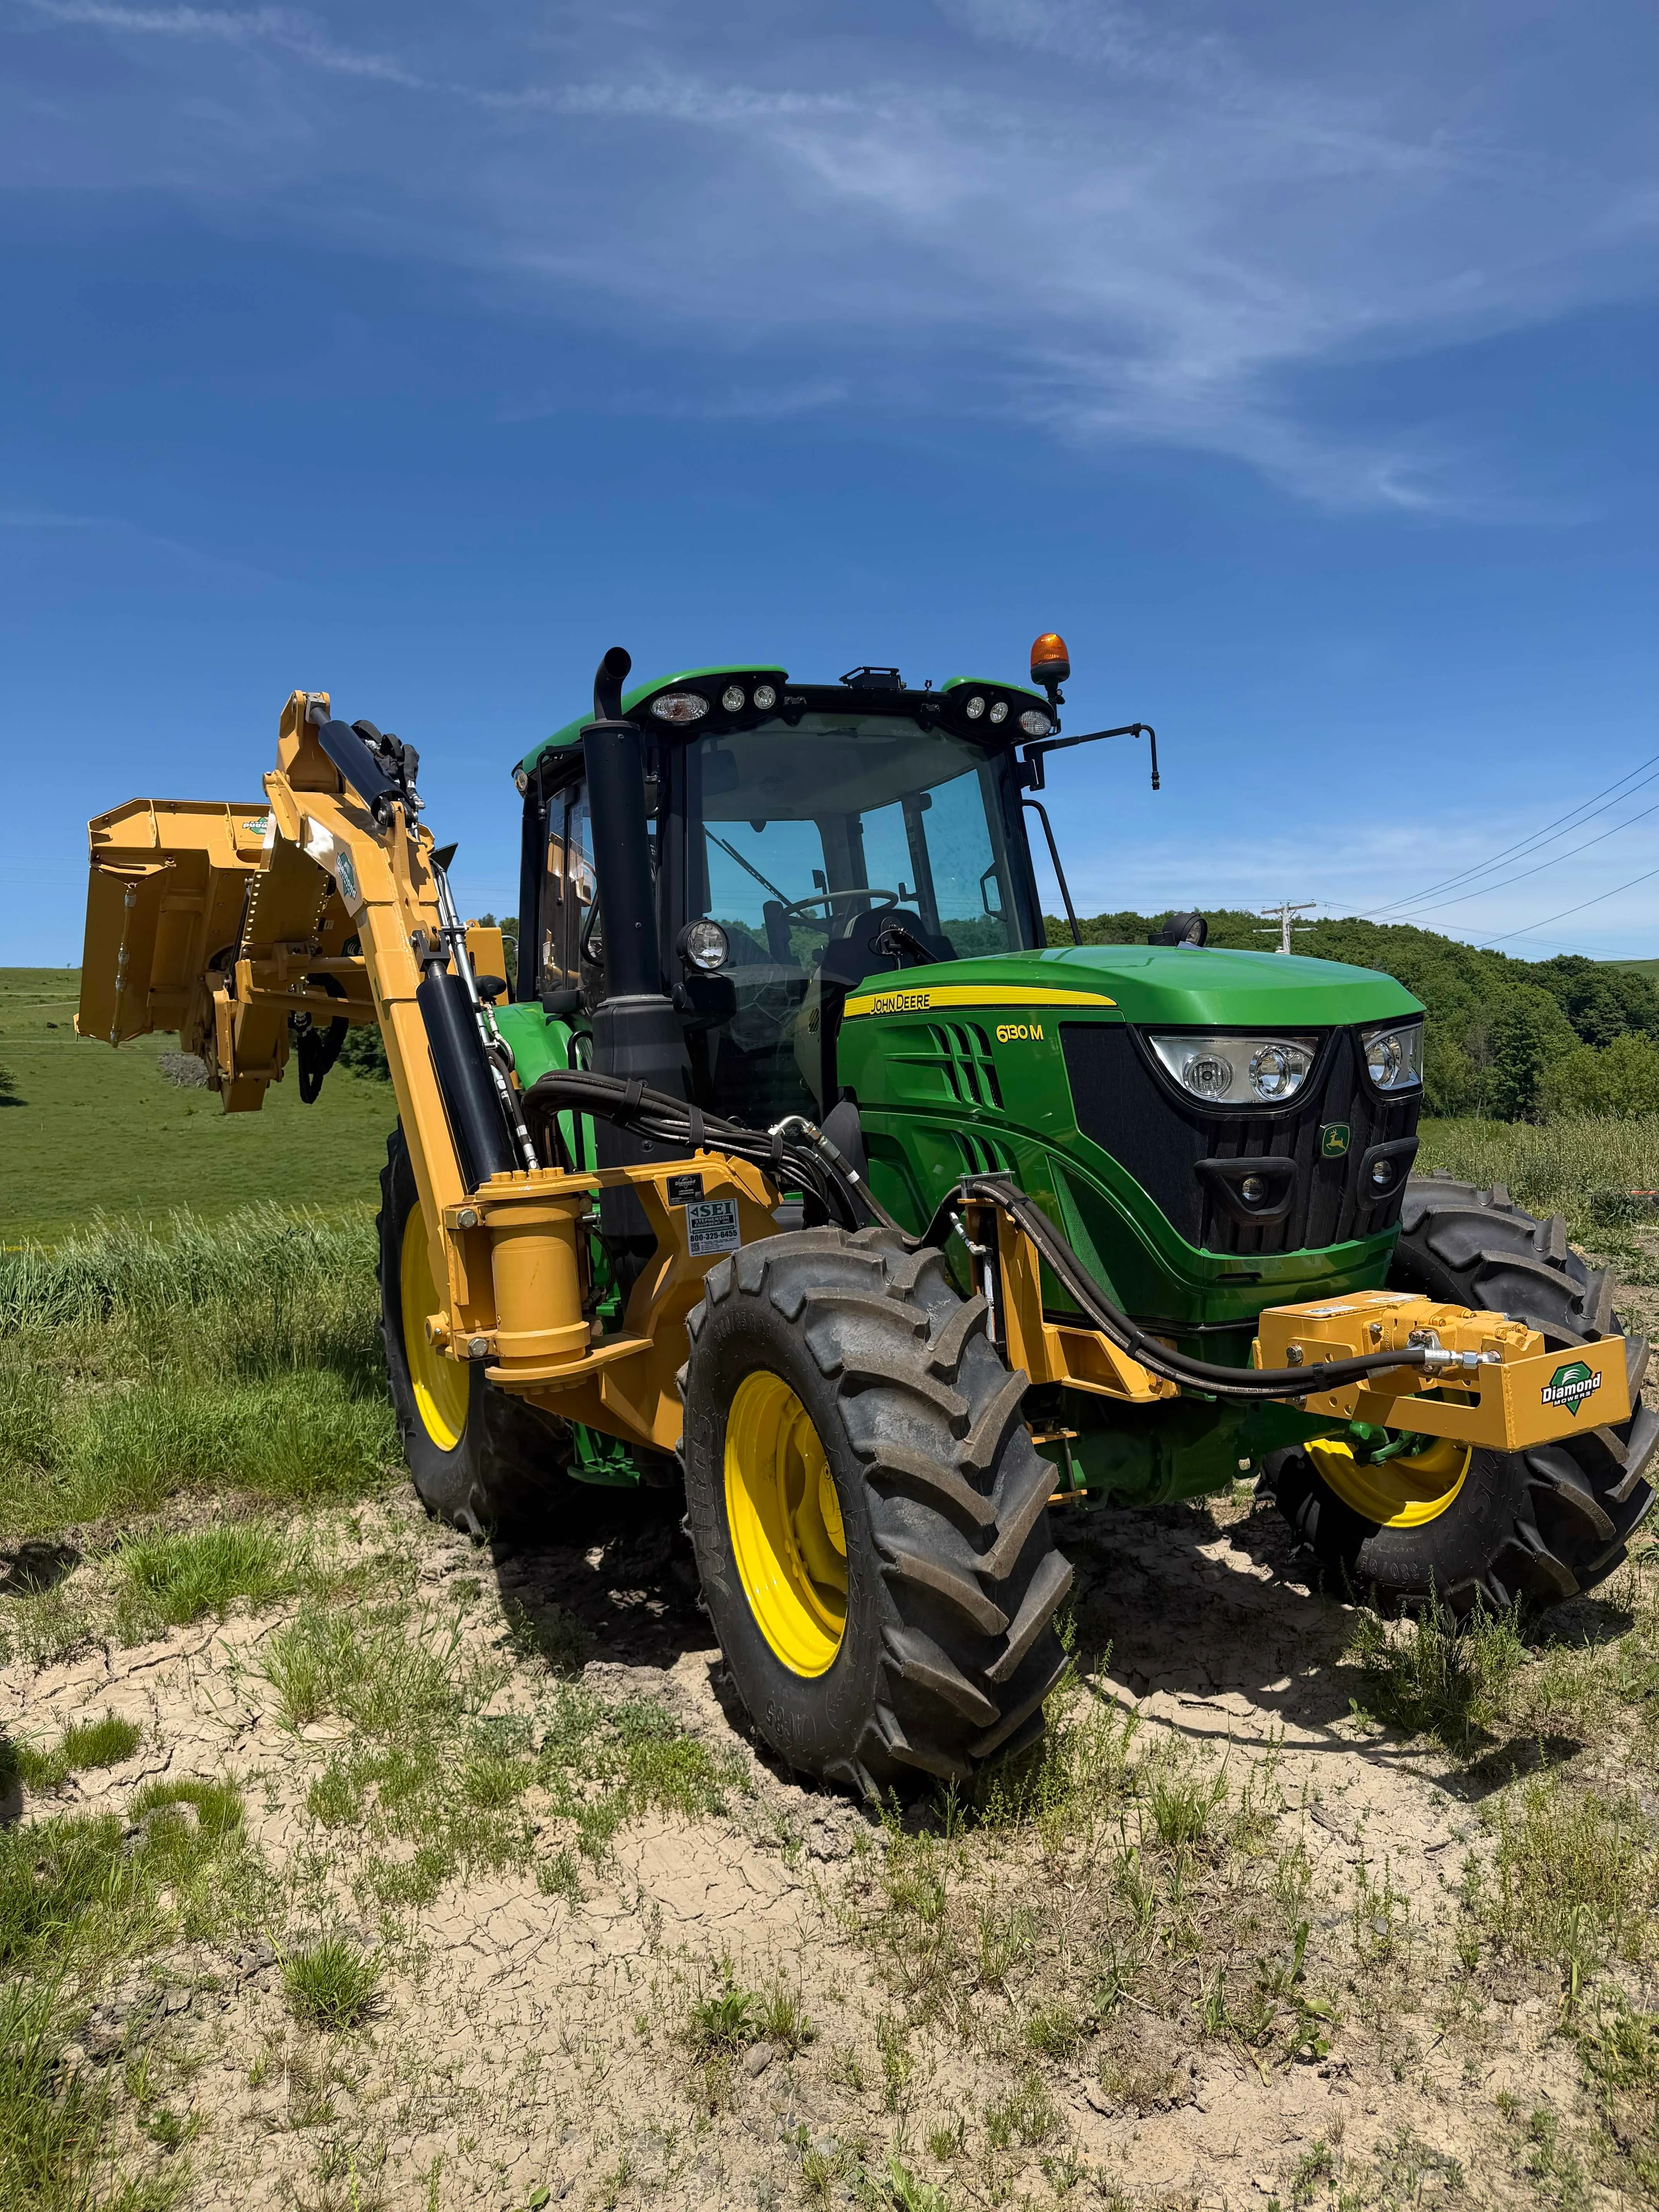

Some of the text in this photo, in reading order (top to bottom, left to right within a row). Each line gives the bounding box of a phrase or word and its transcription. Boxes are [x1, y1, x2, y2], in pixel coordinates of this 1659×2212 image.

[871, 994, 930, 1014] JOHN DEERE
[996, 1024, 1044, 1043] 6130 M
[700, 1202, 732, 1217] SEI
[690, 1230, 737, 1242] 800-325-6455
[1542, 1373, 1601, 1403] Diamond
[1554, 1391, 1590, 1406] MOWERS
